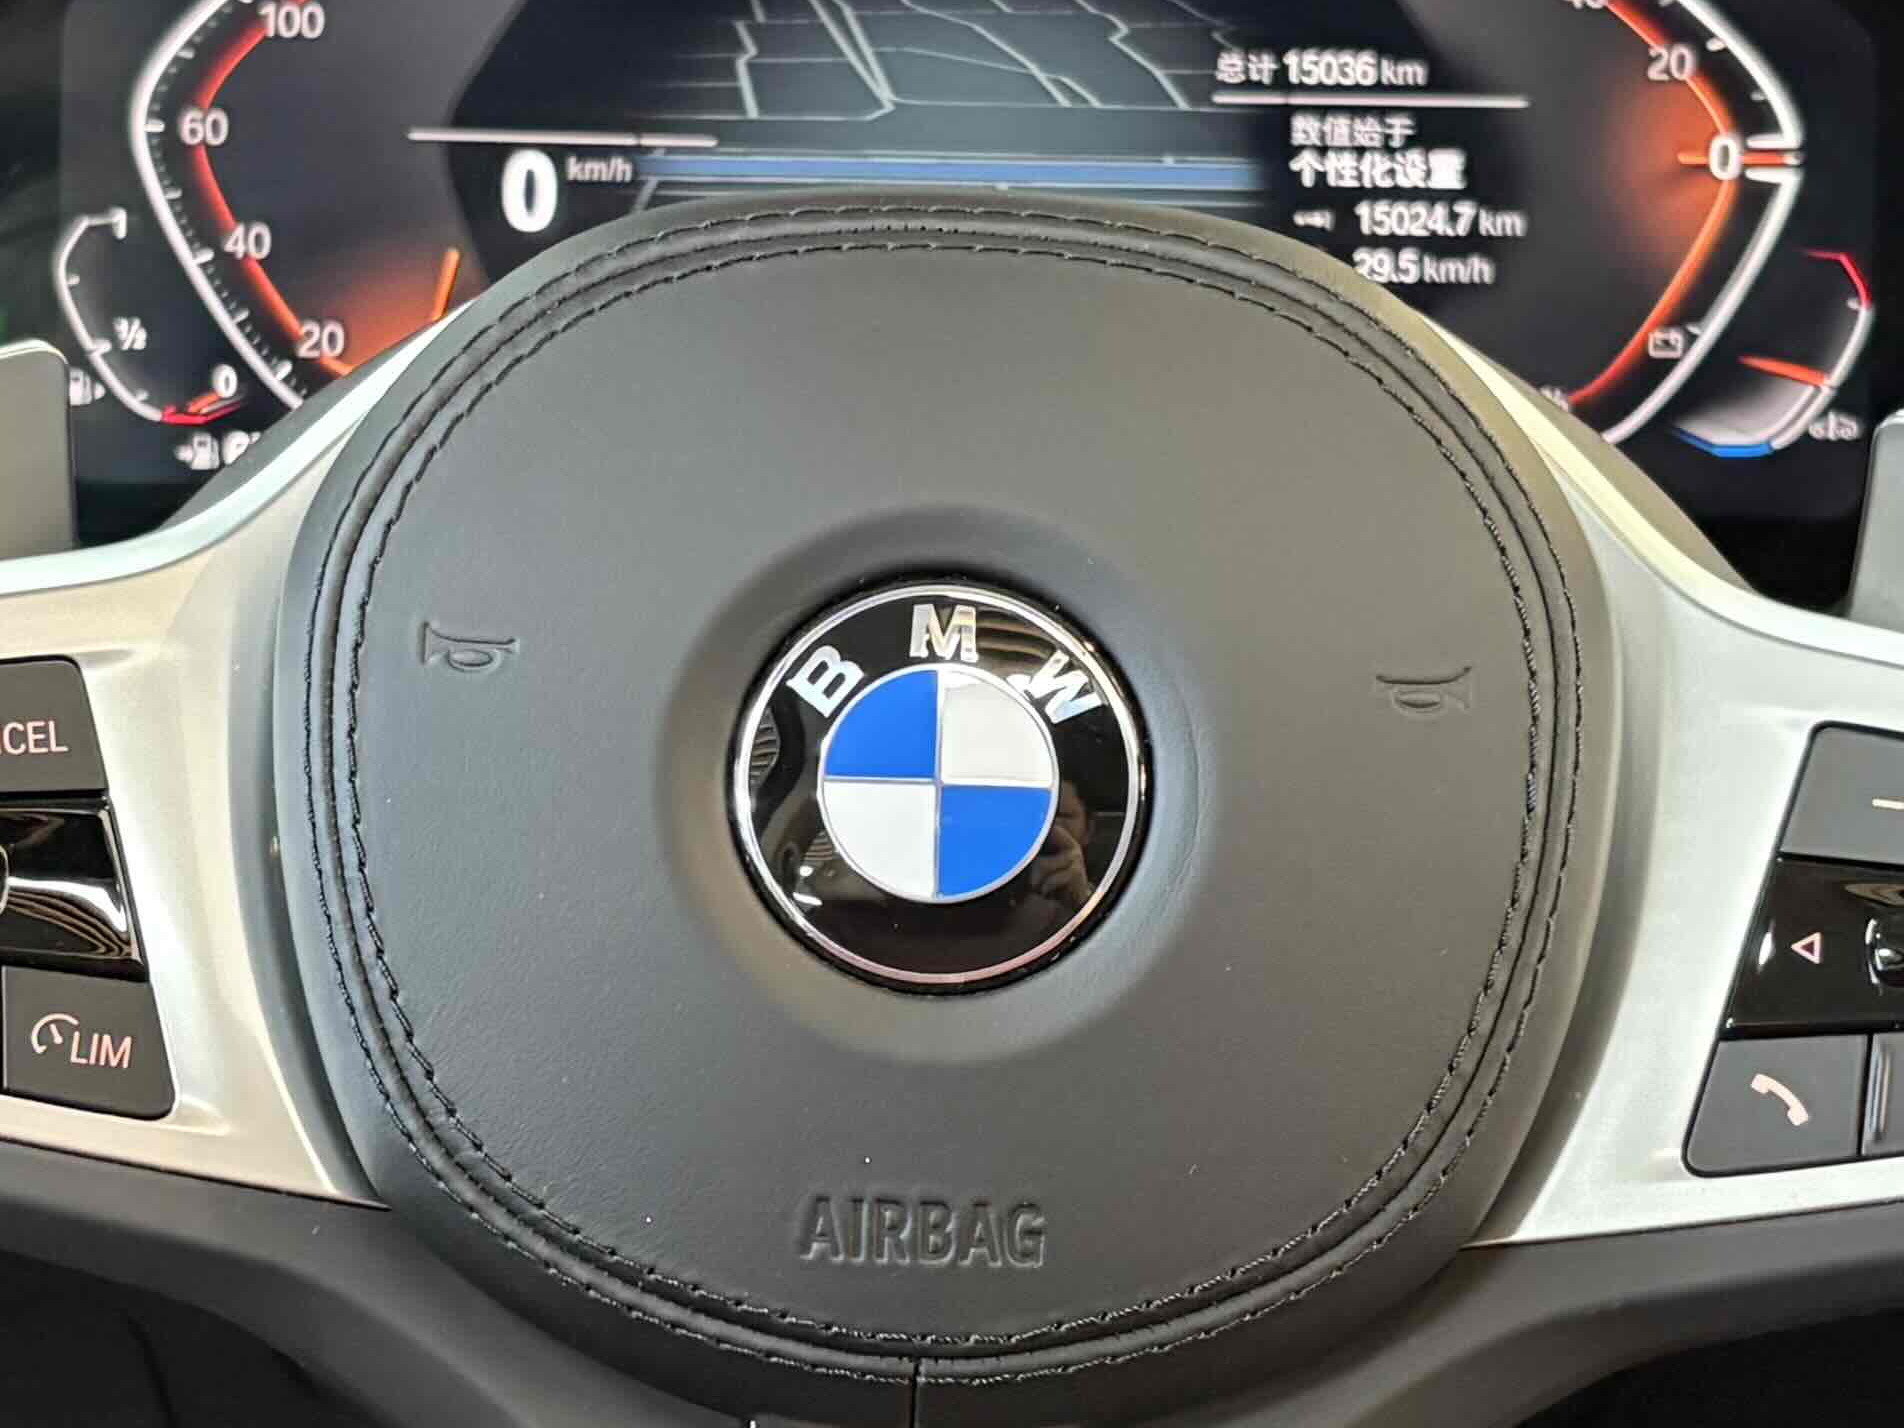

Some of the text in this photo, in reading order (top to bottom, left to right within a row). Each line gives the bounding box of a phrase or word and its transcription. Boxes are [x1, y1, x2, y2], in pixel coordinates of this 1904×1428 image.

[258, 1, 325, 40] 100
[1215, 49, 1428, 86] 总计 15036 km
[1647, 45, 1695, 82] 20
[178, 107, 229, 147] 60
[1290, 114, 1416, 148] 数值始于
[1289, 150, 1467, 189] 个性化设置
[1708, 135, 1741, 181] 0
[500, 149, 634, 233] 0 km/h
[1355, 200, 1527, 237] 15024.7 km
[223, 222, 272, 261] 40
[1424, 254, 1495, 284] km/h
[296, 319, 345, 360] 20
[212, 363, 238, 399] 0
[785, 603, 1107, 725] BMW
[69, 1031, 134, 1070] LIM
[800, 1194, 1047, 1269] AIRBAG
